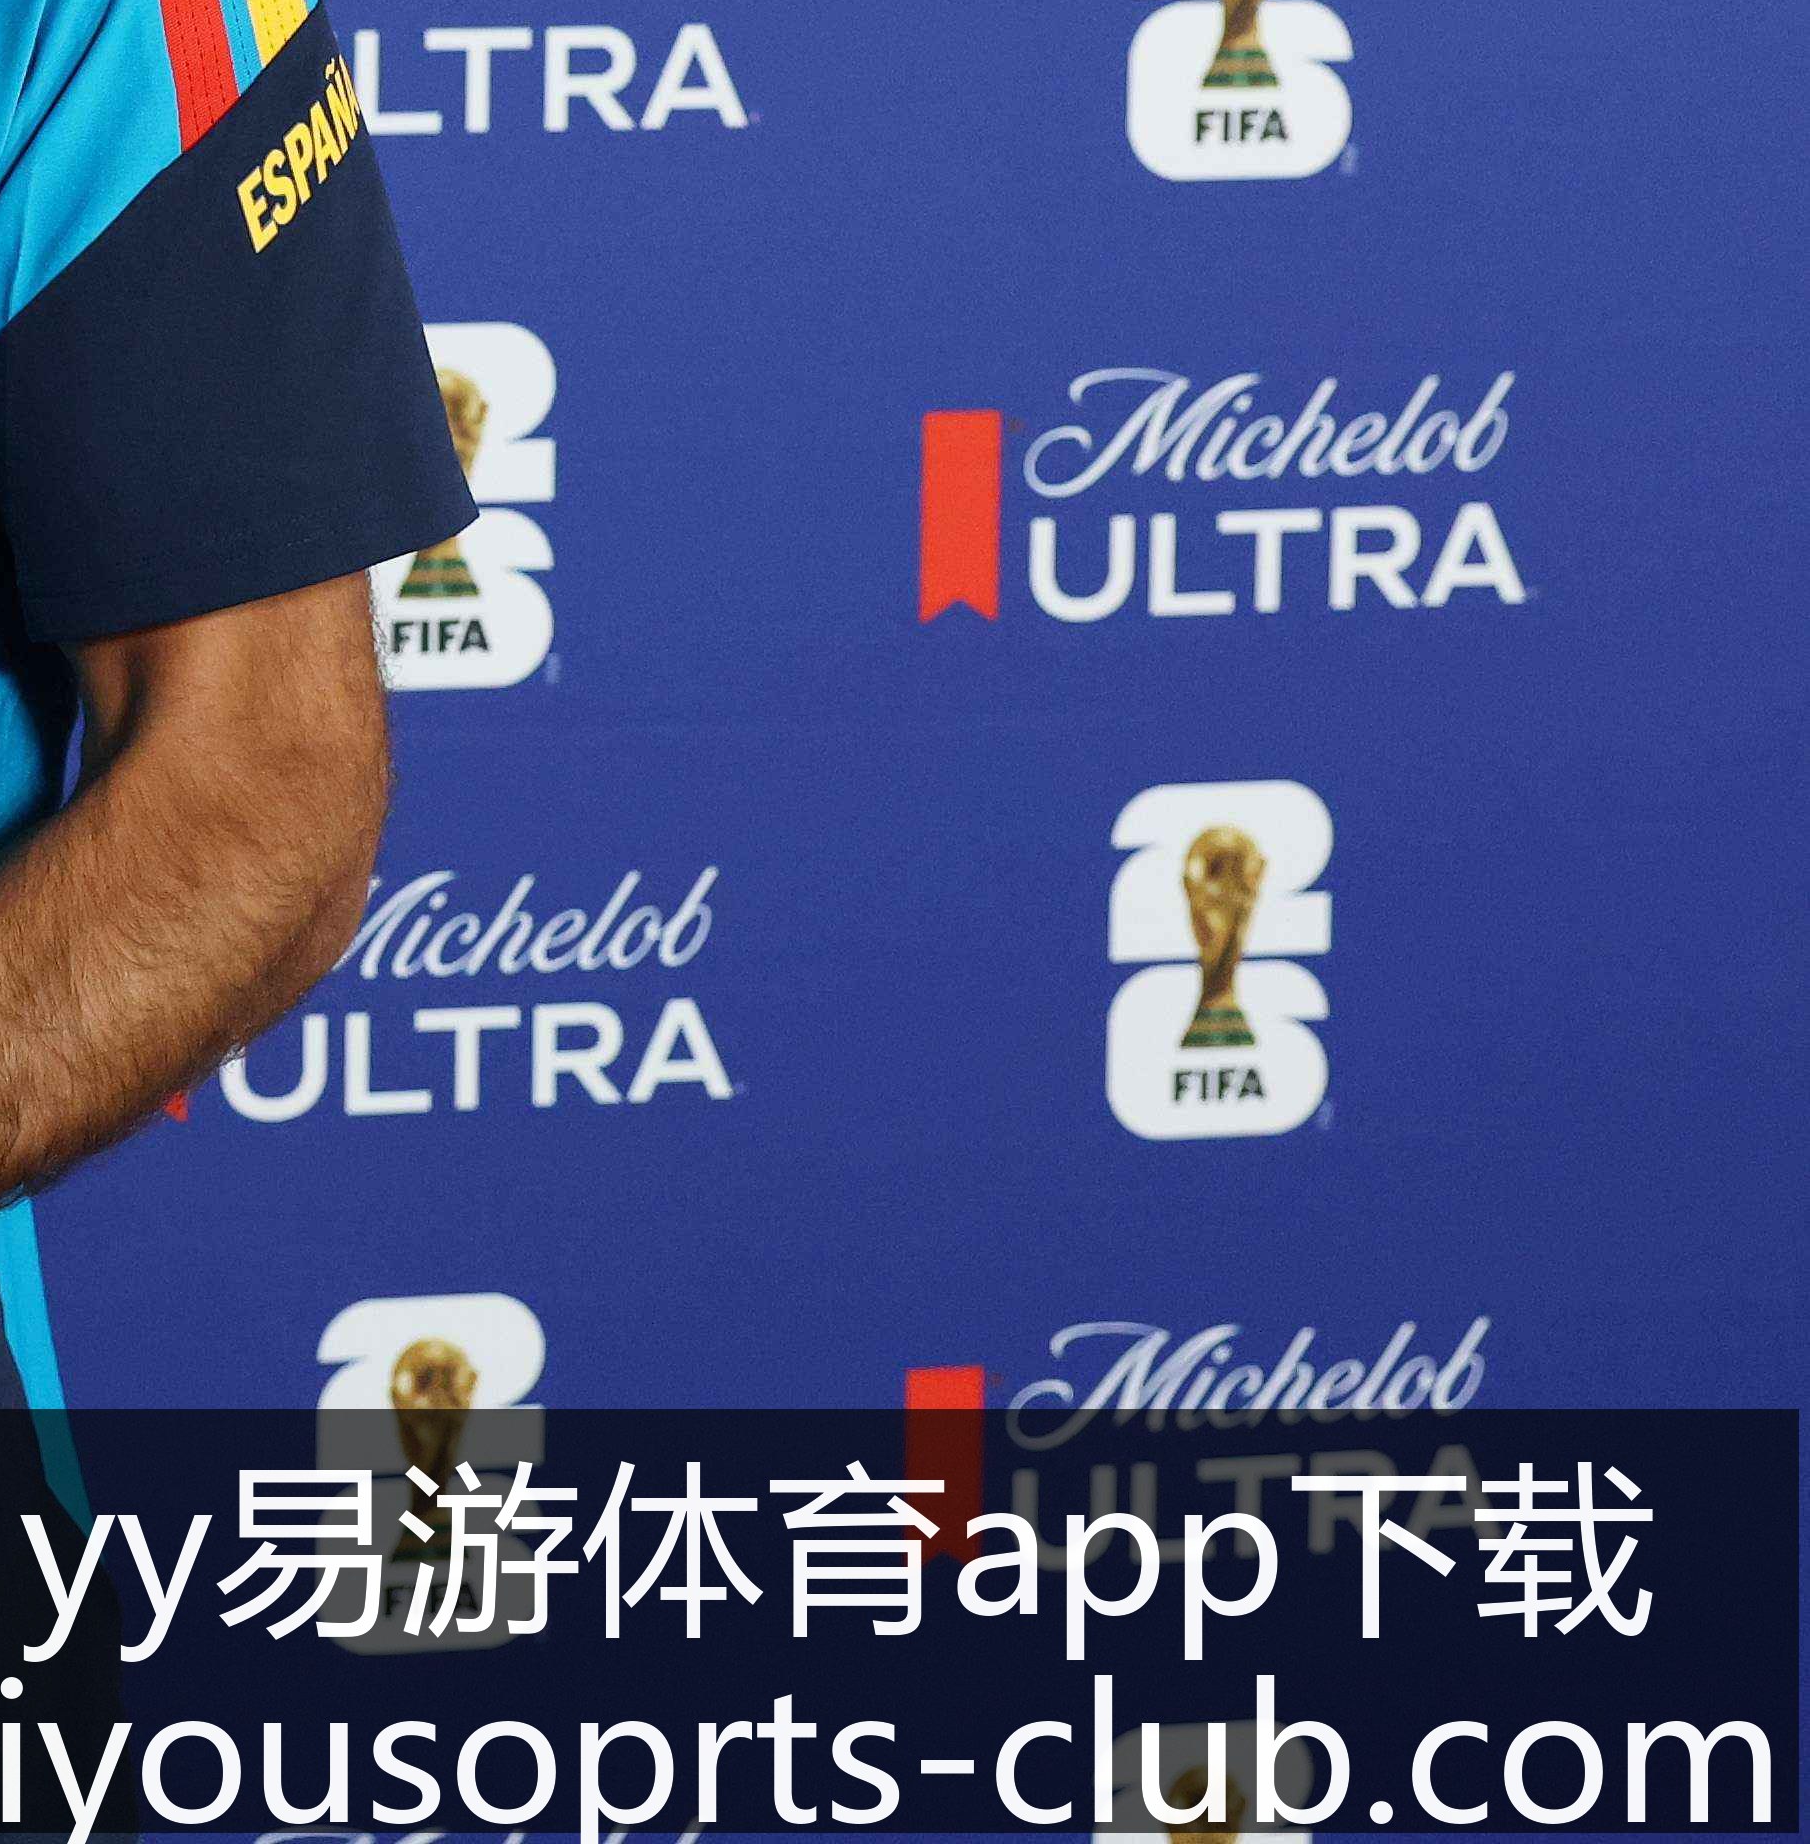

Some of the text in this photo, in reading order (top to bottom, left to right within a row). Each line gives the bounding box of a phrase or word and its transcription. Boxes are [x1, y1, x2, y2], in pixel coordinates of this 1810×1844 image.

[352, 23, 748, 136] LTRA
[1195, 109, 1288, 143] FIFA
[1024, 368, 1515, 498] Michelob
[1029, 502, 1526, 622] ULTRA
[392, 620, 490, 654] FIFA
[220, 998, 733, 1122] ULTRA
[1173, 1068, 1266, 1102] FIFA
[1006, 1316, 1491, 1451] Michelob
